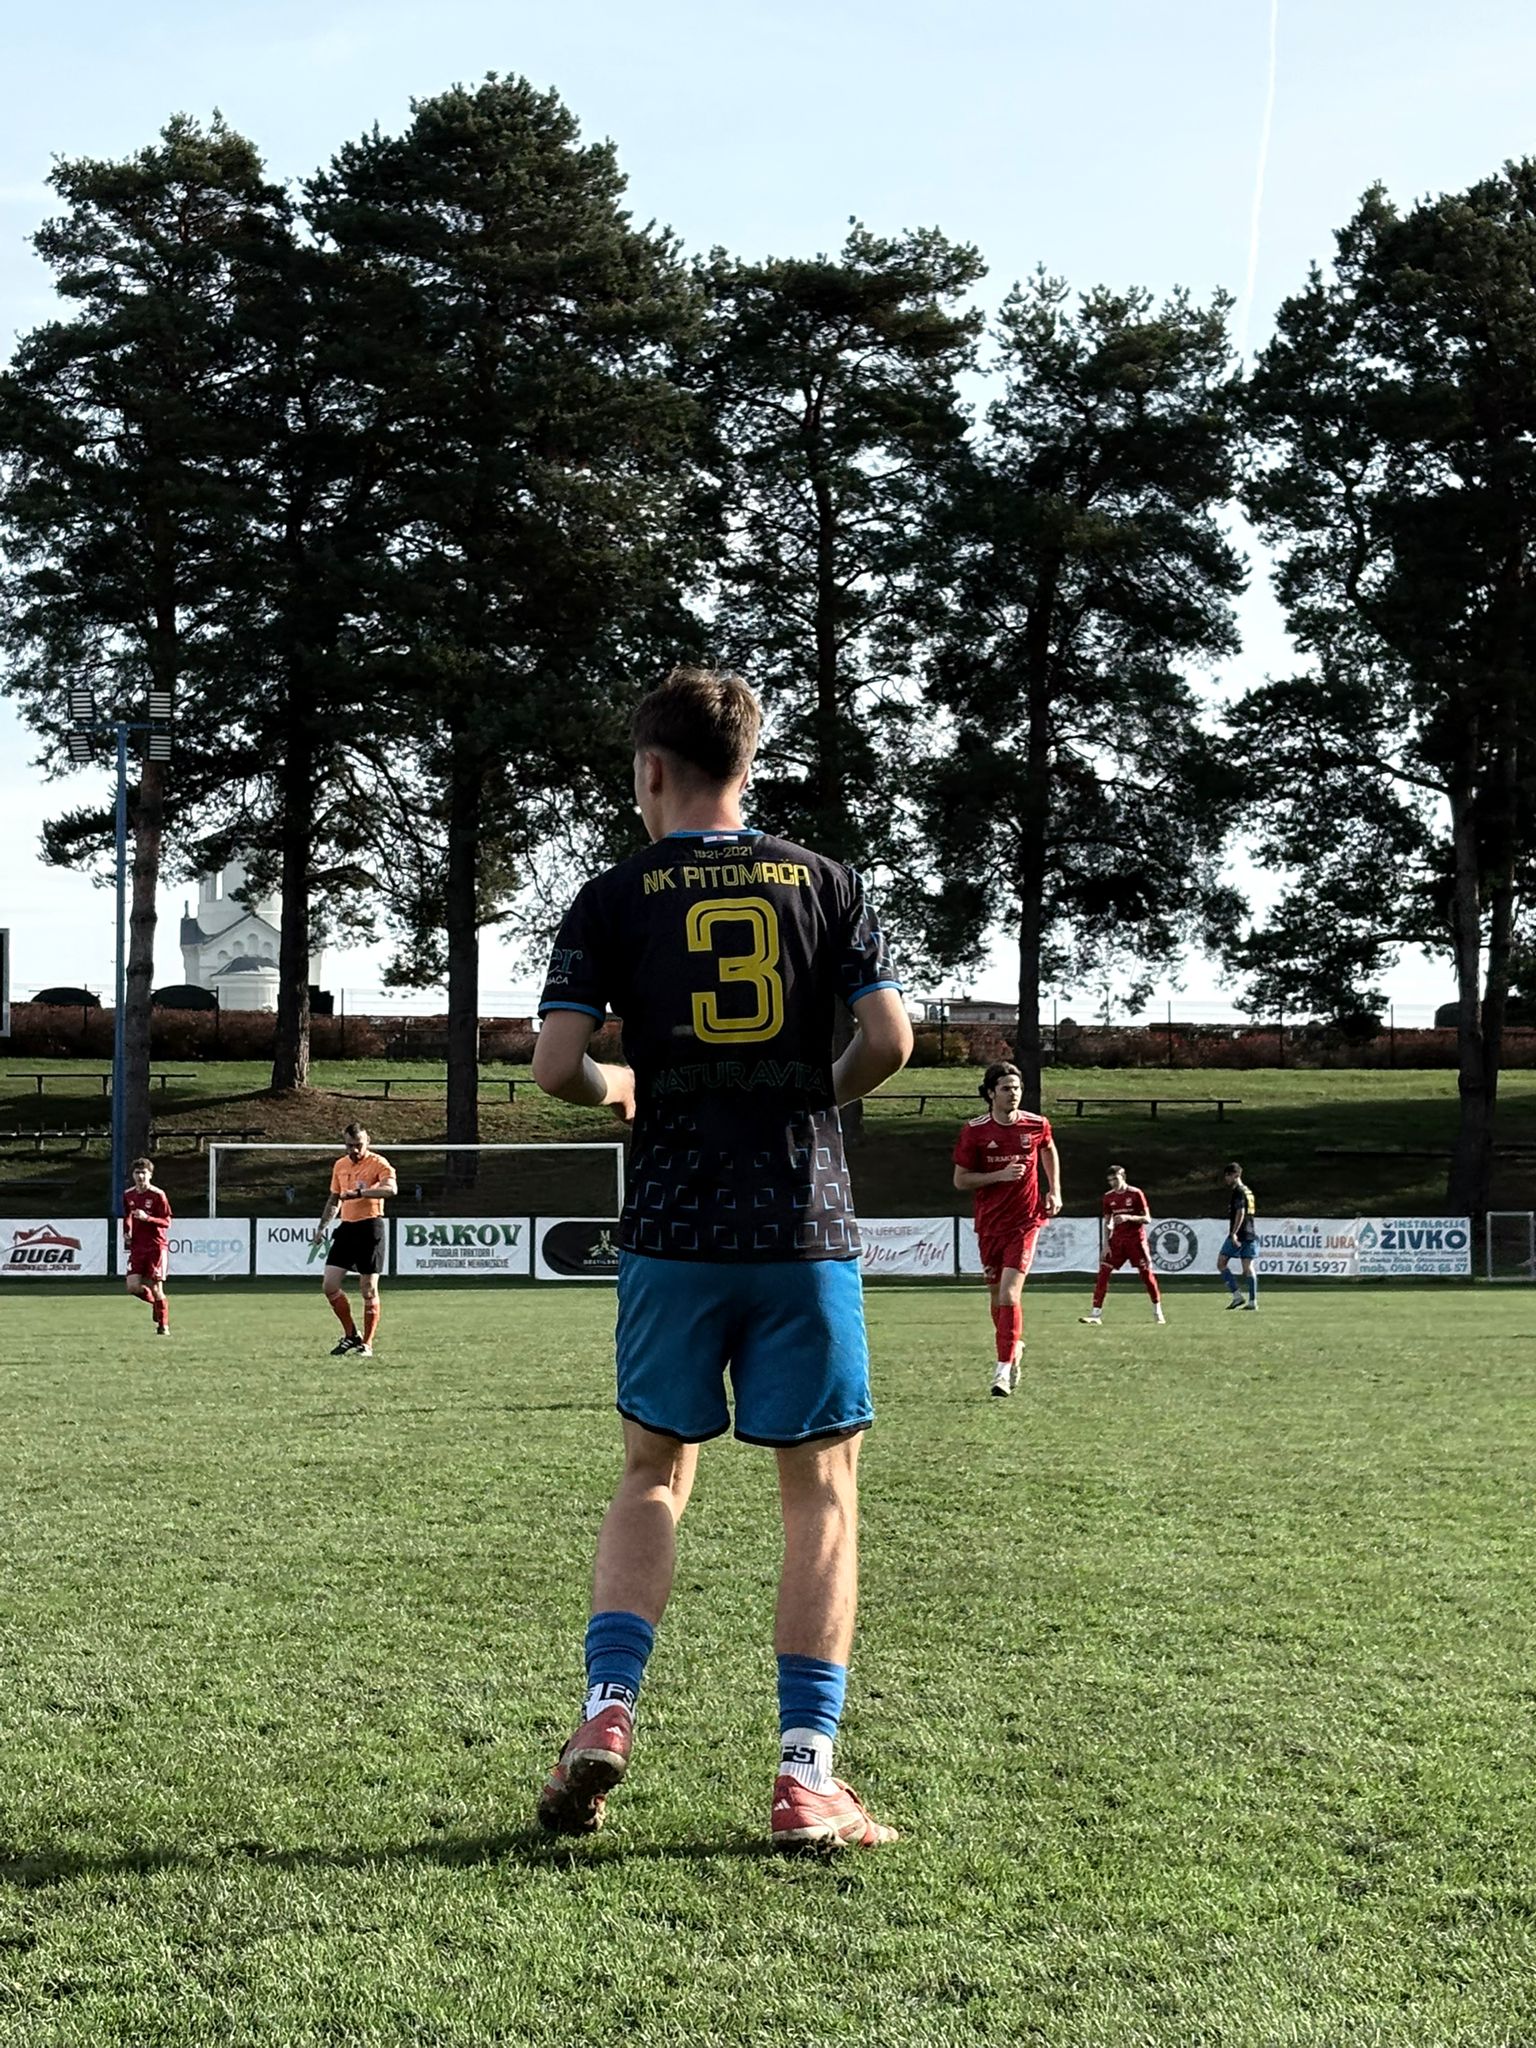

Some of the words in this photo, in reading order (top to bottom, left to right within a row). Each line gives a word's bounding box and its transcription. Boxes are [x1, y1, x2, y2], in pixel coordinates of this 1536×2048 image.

[643, 867, 677, 895] NK
[683, 858, 811, 889] PITOMAČA
[686, 896, 784, 1044] 3
[651, 1060, 828, 1098] NATURAVITA
[268, 1228, 334, 1243] KOMUN
[404, 1224, 522, 1247] BAKOV
[857, 1227, 873, 1236] ON
[1380, 1222, 1467, 1250] ŽIVKO
[168, 1239, 244, 1257] onagro
[1257, 1235, 1322, 1249] NSTALACIJE
[1324, 1235, 1355, 1249] JURA
[10, 1249, 75, 1263] DUGA
[1259, 1260, 1283, 1273] 091
[1287, 1261, 1308, 1273] 761
[1312, 1261, 1348, 1273] 5937
